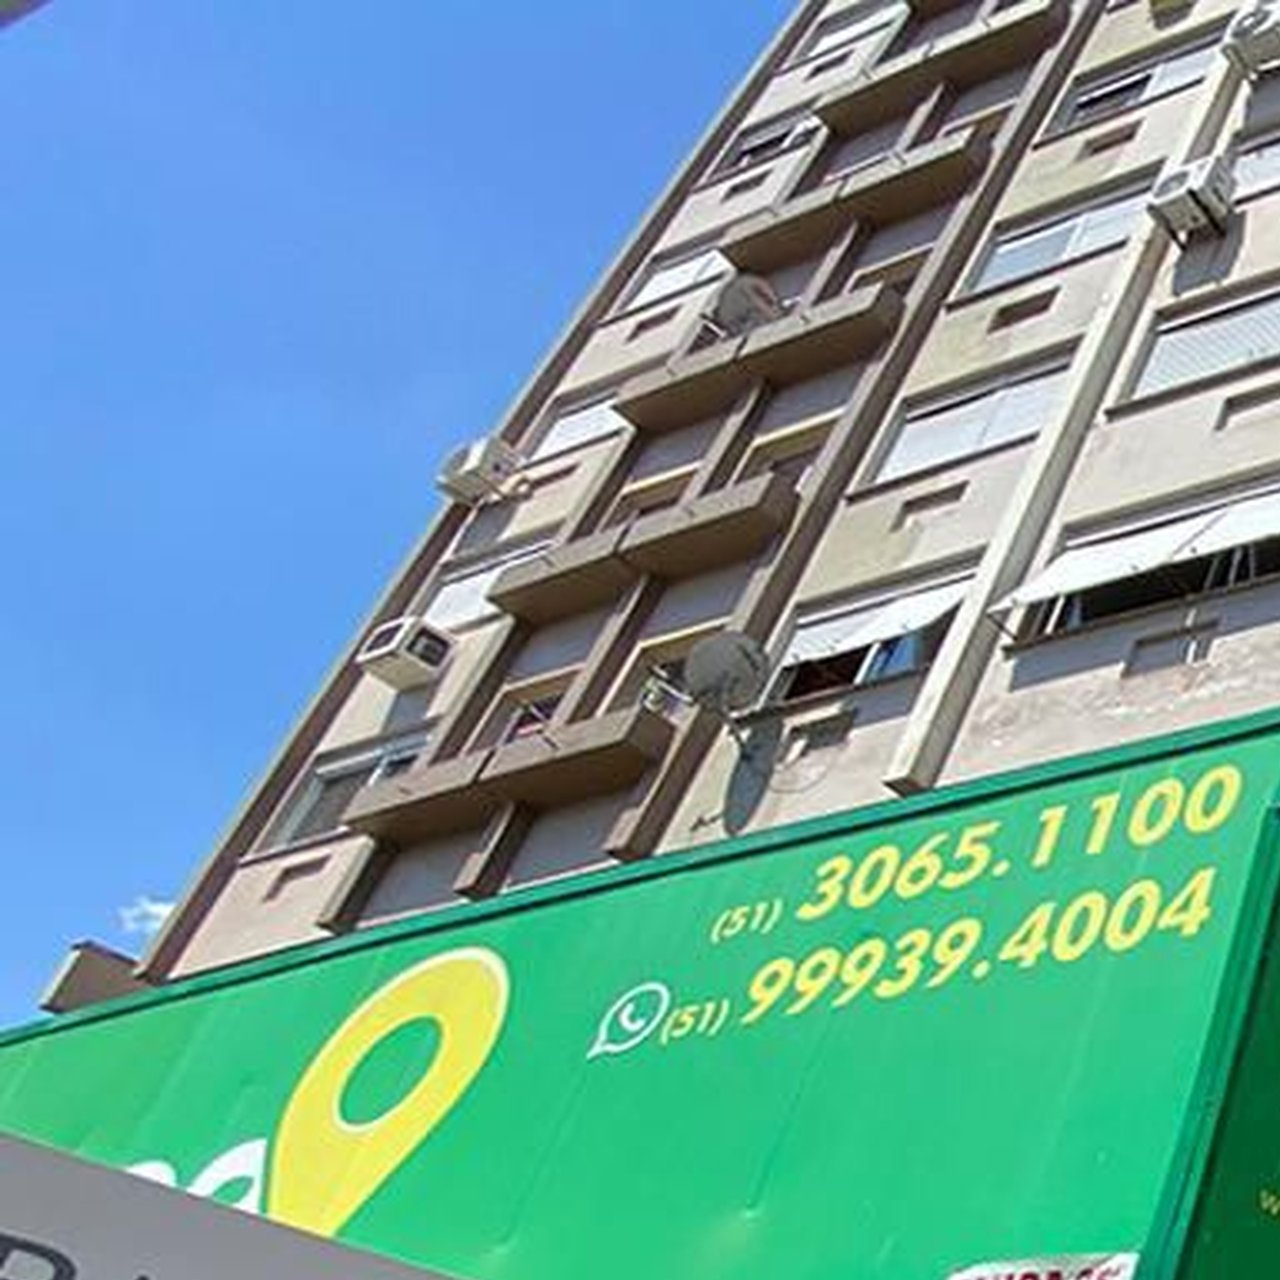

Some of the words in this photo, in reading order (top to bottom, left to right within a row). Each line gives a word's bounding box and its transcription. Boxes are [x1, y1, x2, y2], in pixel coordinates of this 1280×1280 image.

[709, 896, 784, 943] (51)
[796, 764, 1243, 921] 3065.1100
[659, 999, 731, 1045] (51)
[740, 866, 1217, 1026] 99939.4004
